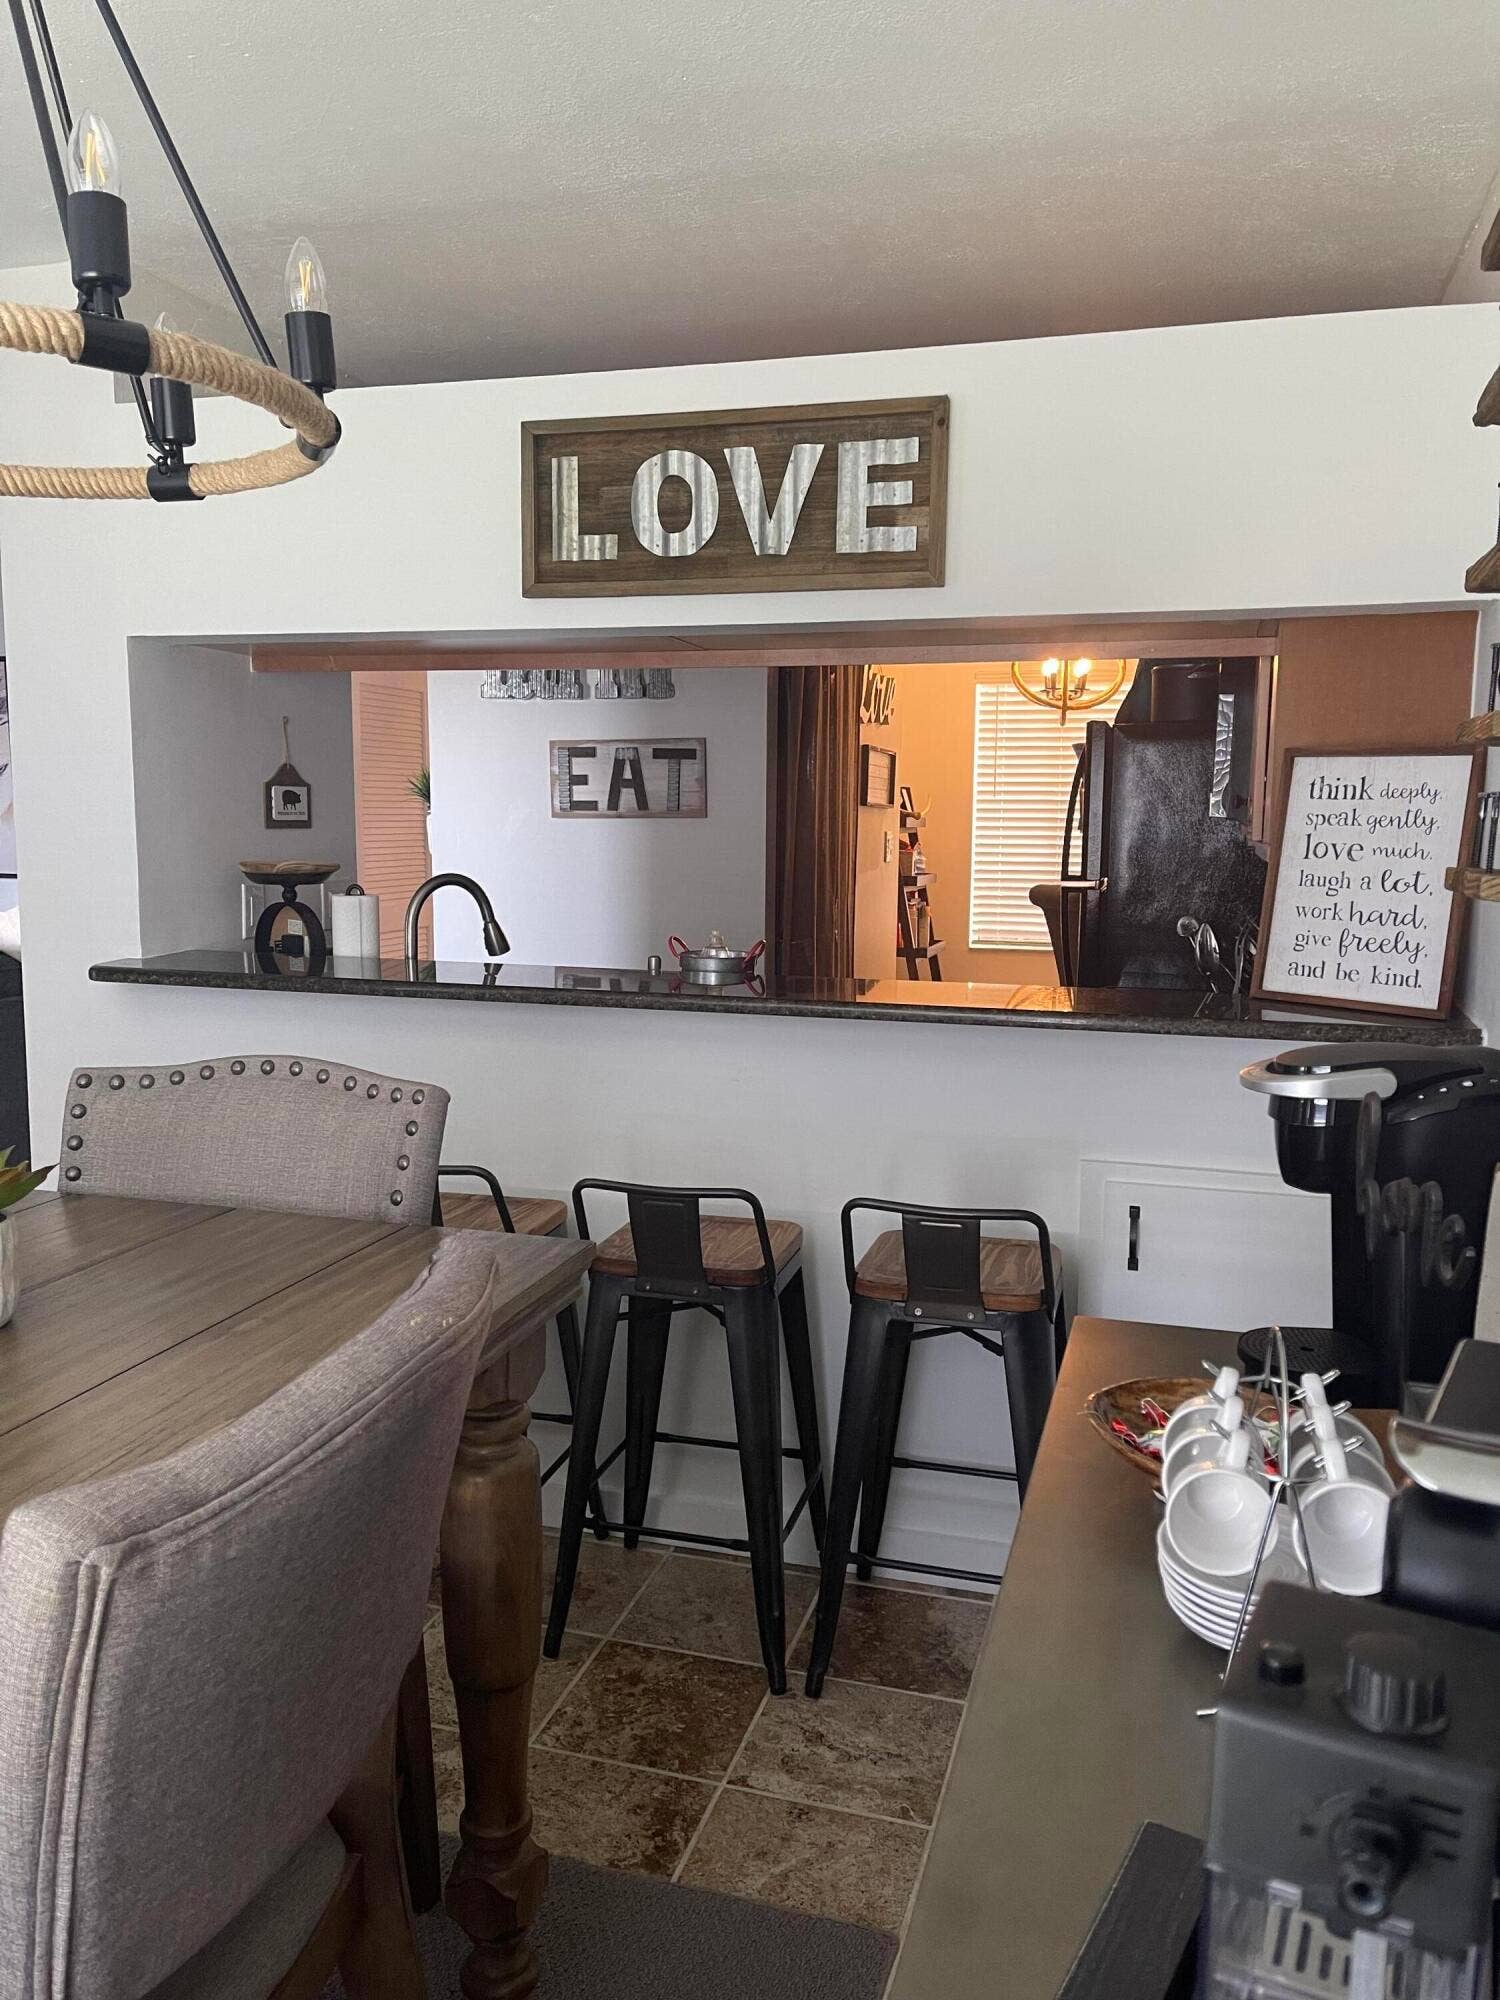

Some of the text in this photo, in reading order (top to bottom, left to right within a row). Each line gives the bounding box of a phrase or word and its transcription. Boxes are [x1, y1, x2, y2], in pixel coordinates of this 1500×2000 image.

[551, 436, 919, 561] LOVE
[557, 746, 697, 812] EAT
[1308, 775, 1375, 801] think
[1305, 808, 1363, 831] speak
[1303, 832, 1364, 862] love
[1298, 869, 1351, 897] laugh
[1359, 875, 1372, 891] a
[1295, 902, 1343, 921] work
[1292, 929, 1332, 952] give
[1287, 960, 1422, 989] and be kind.
